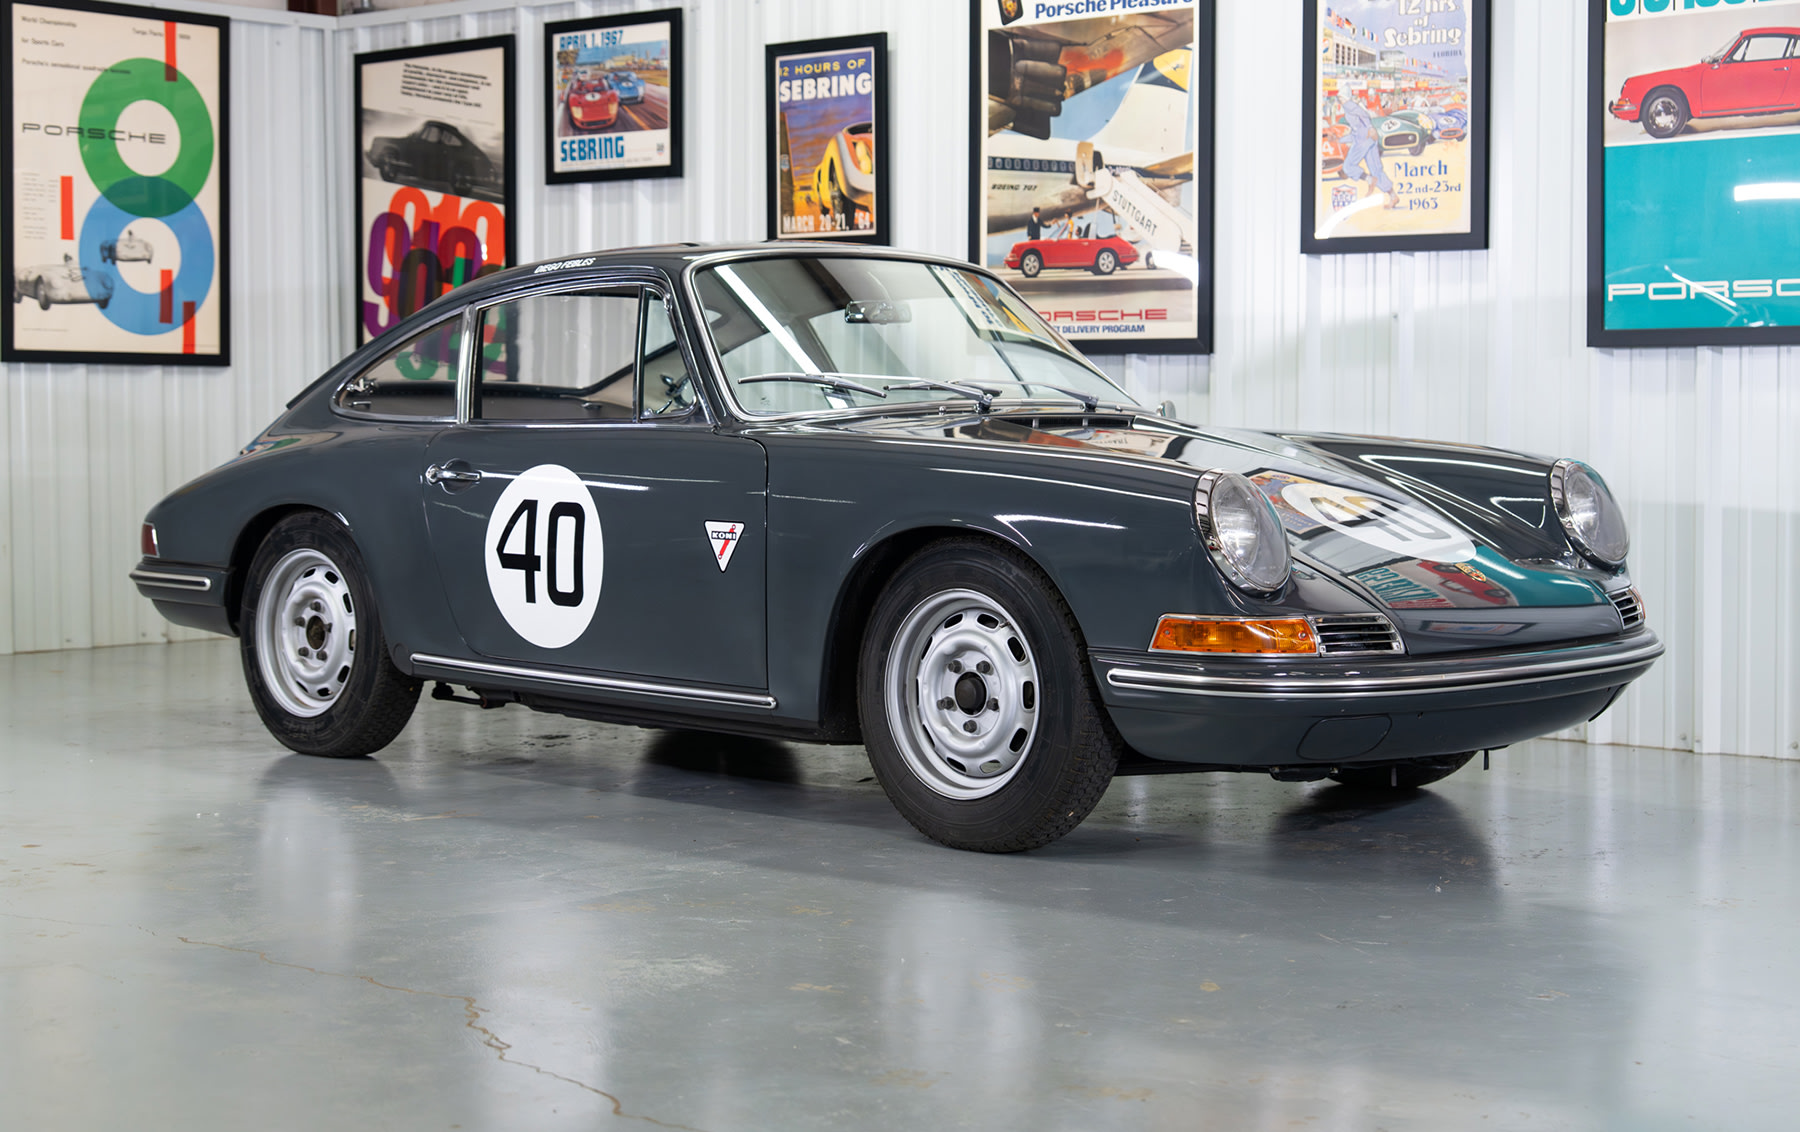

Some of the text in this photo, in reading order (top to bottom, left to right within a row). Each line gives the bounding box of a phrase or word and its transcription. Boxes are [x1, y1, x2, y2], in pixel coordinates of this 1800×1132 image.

[1035, 0, 1194, 18] Porsche Pleas
[1414, 15, 1429, 28] of
[560, 34, 587, 48] APRIL
[1383, 25, 1462, 48] Sebring
[779, 58, 866, 77] 12 HOURS OF
[779, 72, 872, 103] SEBRING
[22, 122, 167, 144] PORSCHE
[560, 135, 625, 162] SEBRING
[1394, 159, 1448, 178] March
[1112, 189, 1158, 236] STUTTGART
[1409, 197, 1439, 211] 1963
[783, 214, 815, 233] MARCH
[1062, 325, 1100, 334] DELIVERY
[1102, 324, 1146, 334] PROGRAM
[711, 531, 736, 540] KONI
[496, 498, 586, 608] 40
